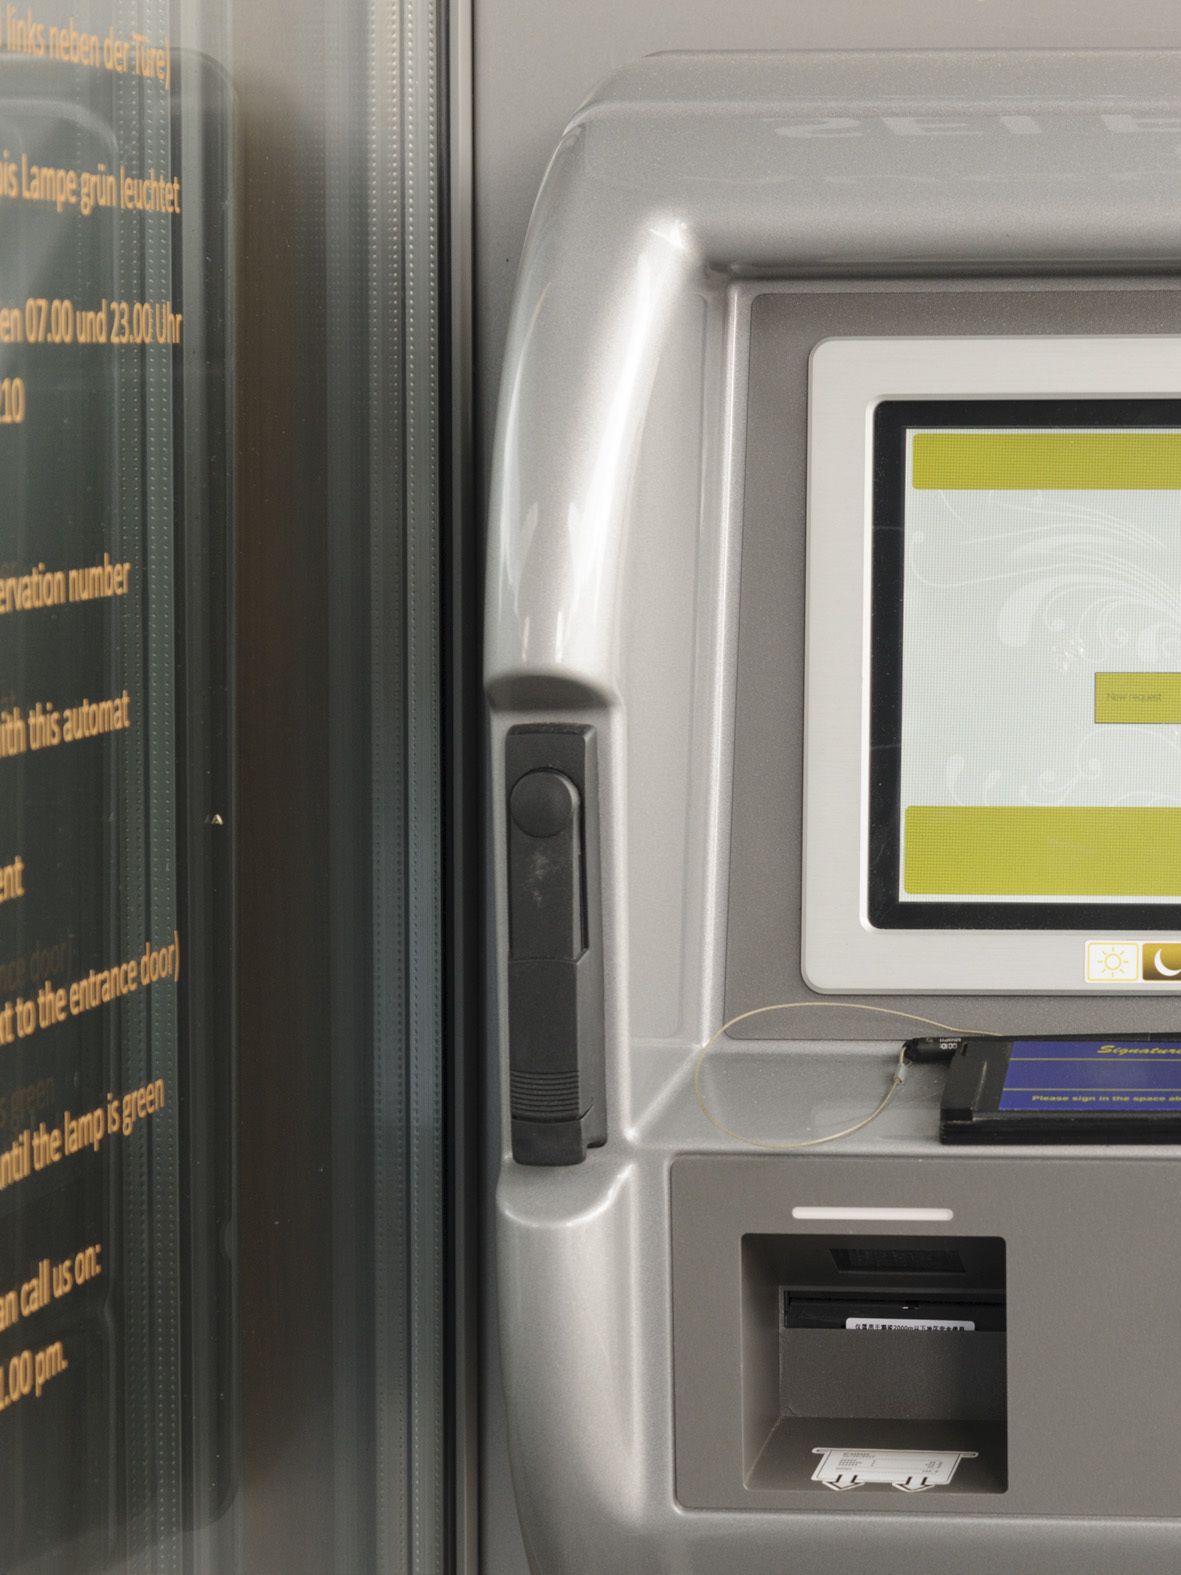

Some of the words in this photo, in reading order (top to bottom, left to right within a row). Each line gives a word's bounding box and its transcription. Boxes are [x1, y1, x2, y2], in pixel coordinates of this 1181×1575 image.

[49, 15, 99, 68] neben
[104, 25, 129, 74] der
[21, 153, 78, 213] Lampe
[80, 163, 117, 216] grün
[120, 165, 181, 213] leuchtet
[25, 297, 74, 344] 07.00
[75, 299, 108, 343] und
[110, 301, 151, 344] 23.00
[155, 301, 182, 344] Uhr
[68, 552, 131, 602] number
[28, 702, 61, 751] this
[16, 997, 36, 1038] to
[37, 980, 67, 1029] the
[69, 969, 137, 1016] entrance
[140, 929, 181, 982] door)
[1072, 1095, 1096, 1103] sign
[0, 1129, 31, 1191] ntil
[32, 1122, 63, 1171] the
[64, 1110, 105, 1152] lamp
[107, 1092, 121, 1134] is
[122, 1078, 165, 1136] green
[20, 1258, 51, 1317] call
[52, 1258, 73, 1298] us
[74, 1243, 102, 1285] on:
[35, 1340, 69, 1397] pm.
